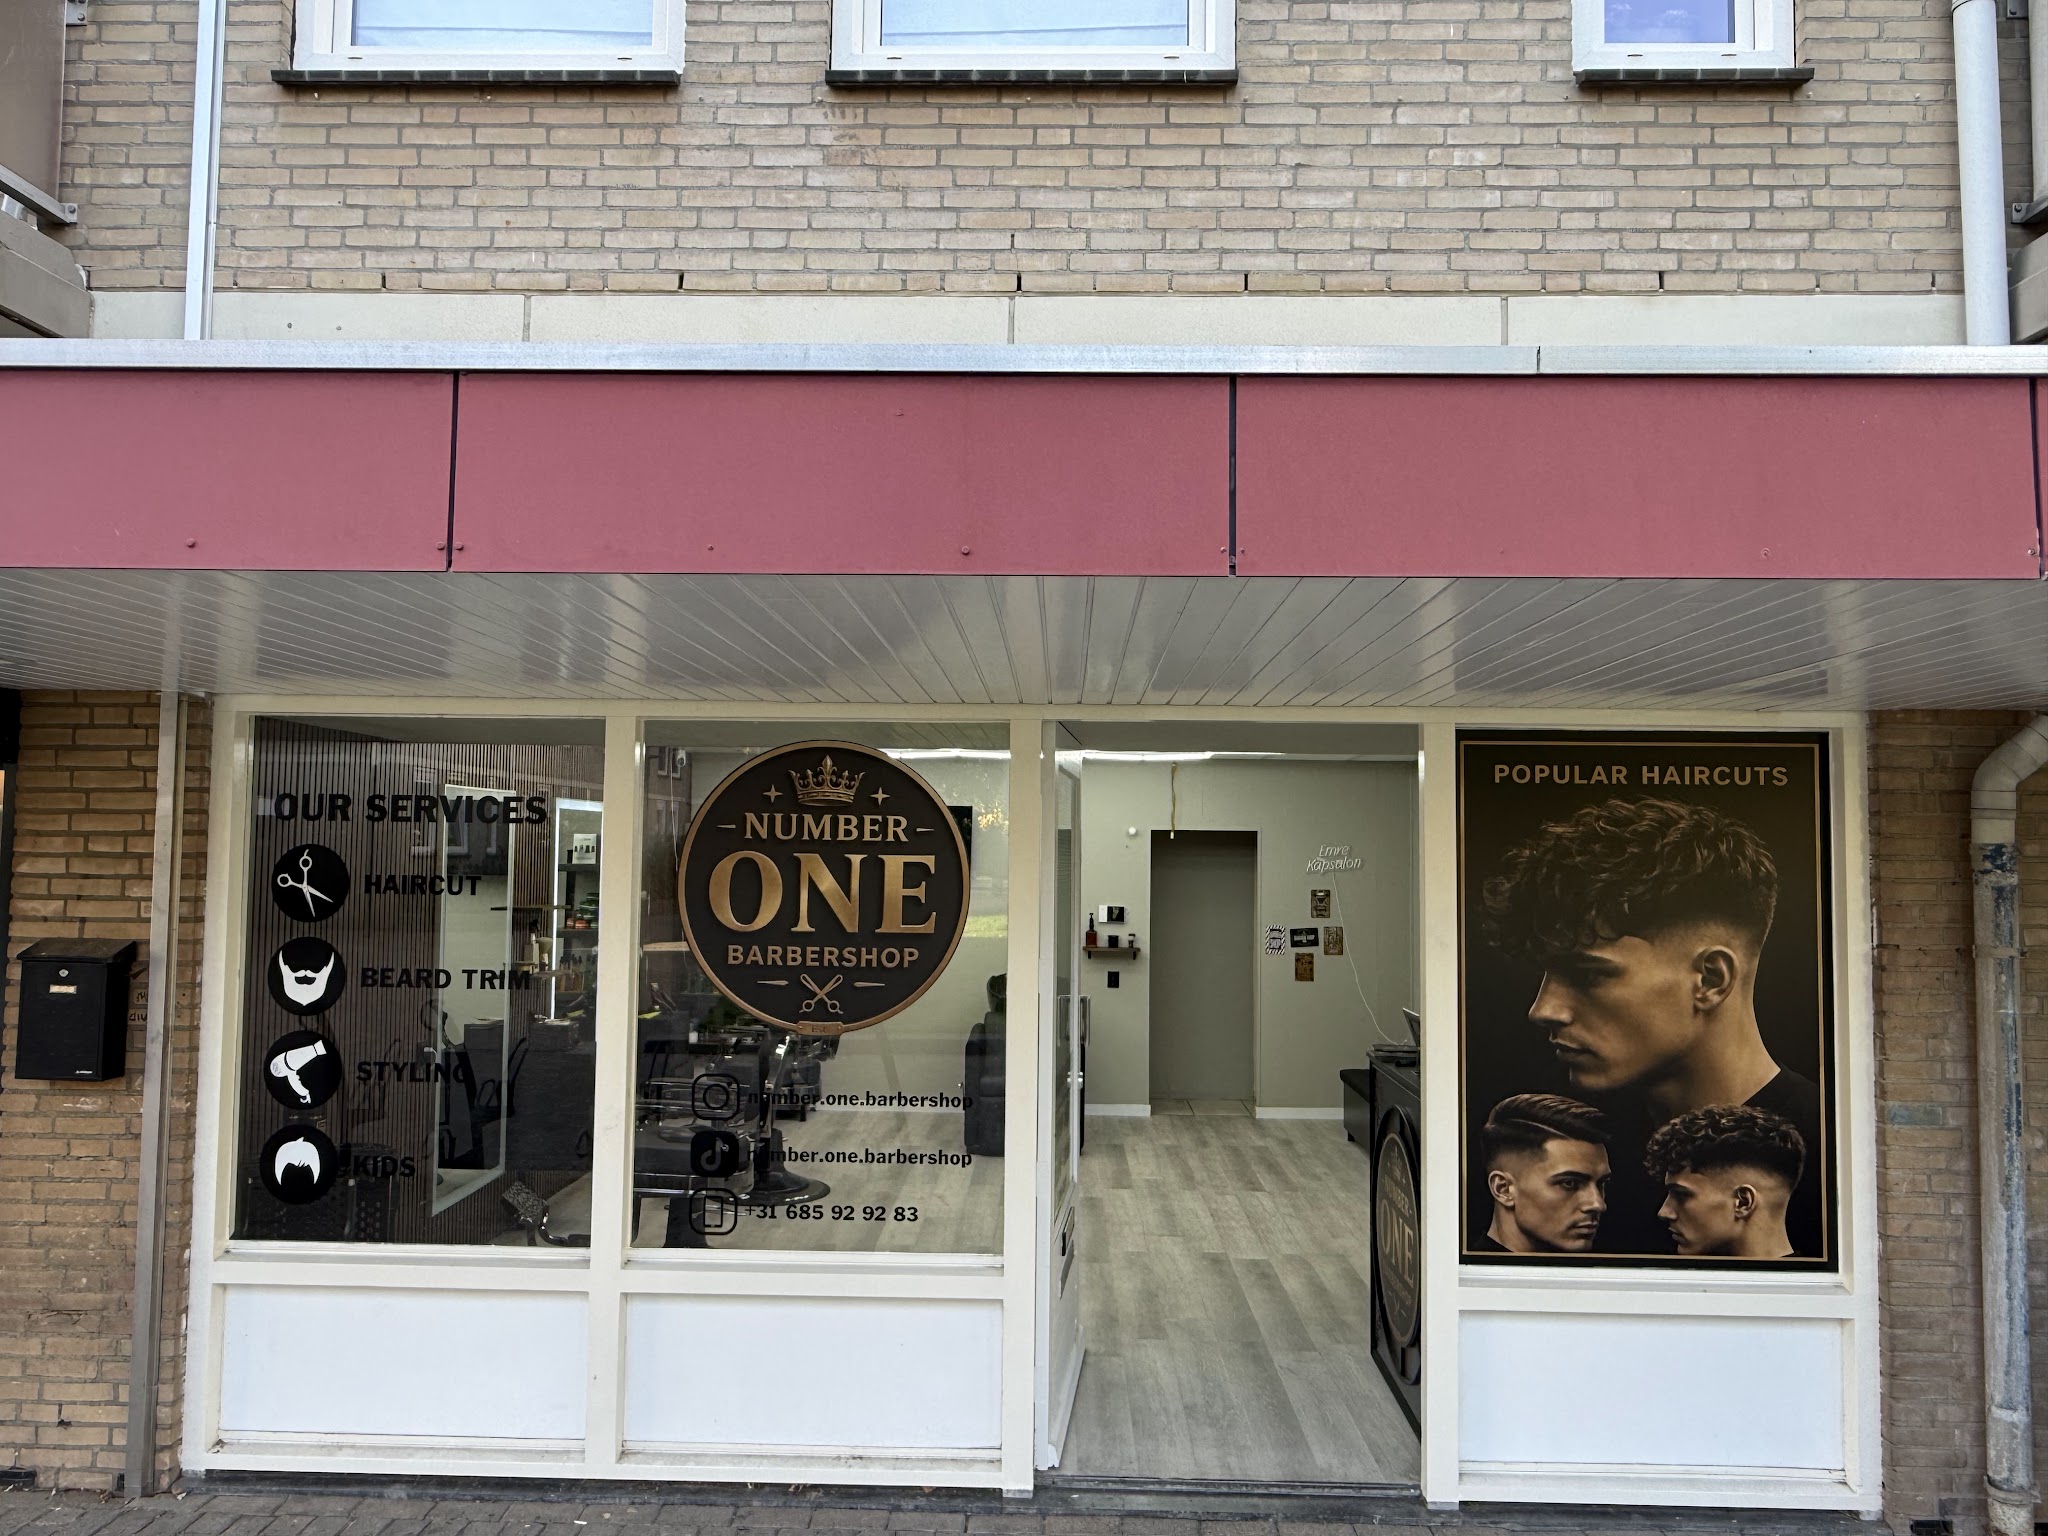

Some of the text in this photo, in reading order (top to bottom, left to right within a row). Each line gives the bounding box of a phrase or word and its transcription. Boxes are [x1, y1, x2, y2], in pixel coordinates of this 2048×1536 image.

[1494, 764, 1788, 786] POPULAR HAIRCUTS
[275, 793, 547, 824] OUR SERVICES
[744, 812, 909, 842] NUMBER
[1319, 844, 1350, 856] Emre
[1306, 856, 1361, 872] Kapsalon
[364, 875, 481, 896] HAIRCUT
[709, 850, 936, 934] ONE
[727, 944, 919, 968] BARBERSHOP
[361, 968, 531, 990] BEARD TRIM
[353, 1155, 415, 1177] KIDS
[745, 1205, 918, 1222] +31 685 92 92 83
[1381, 1199, 1414, 1288] ONE
